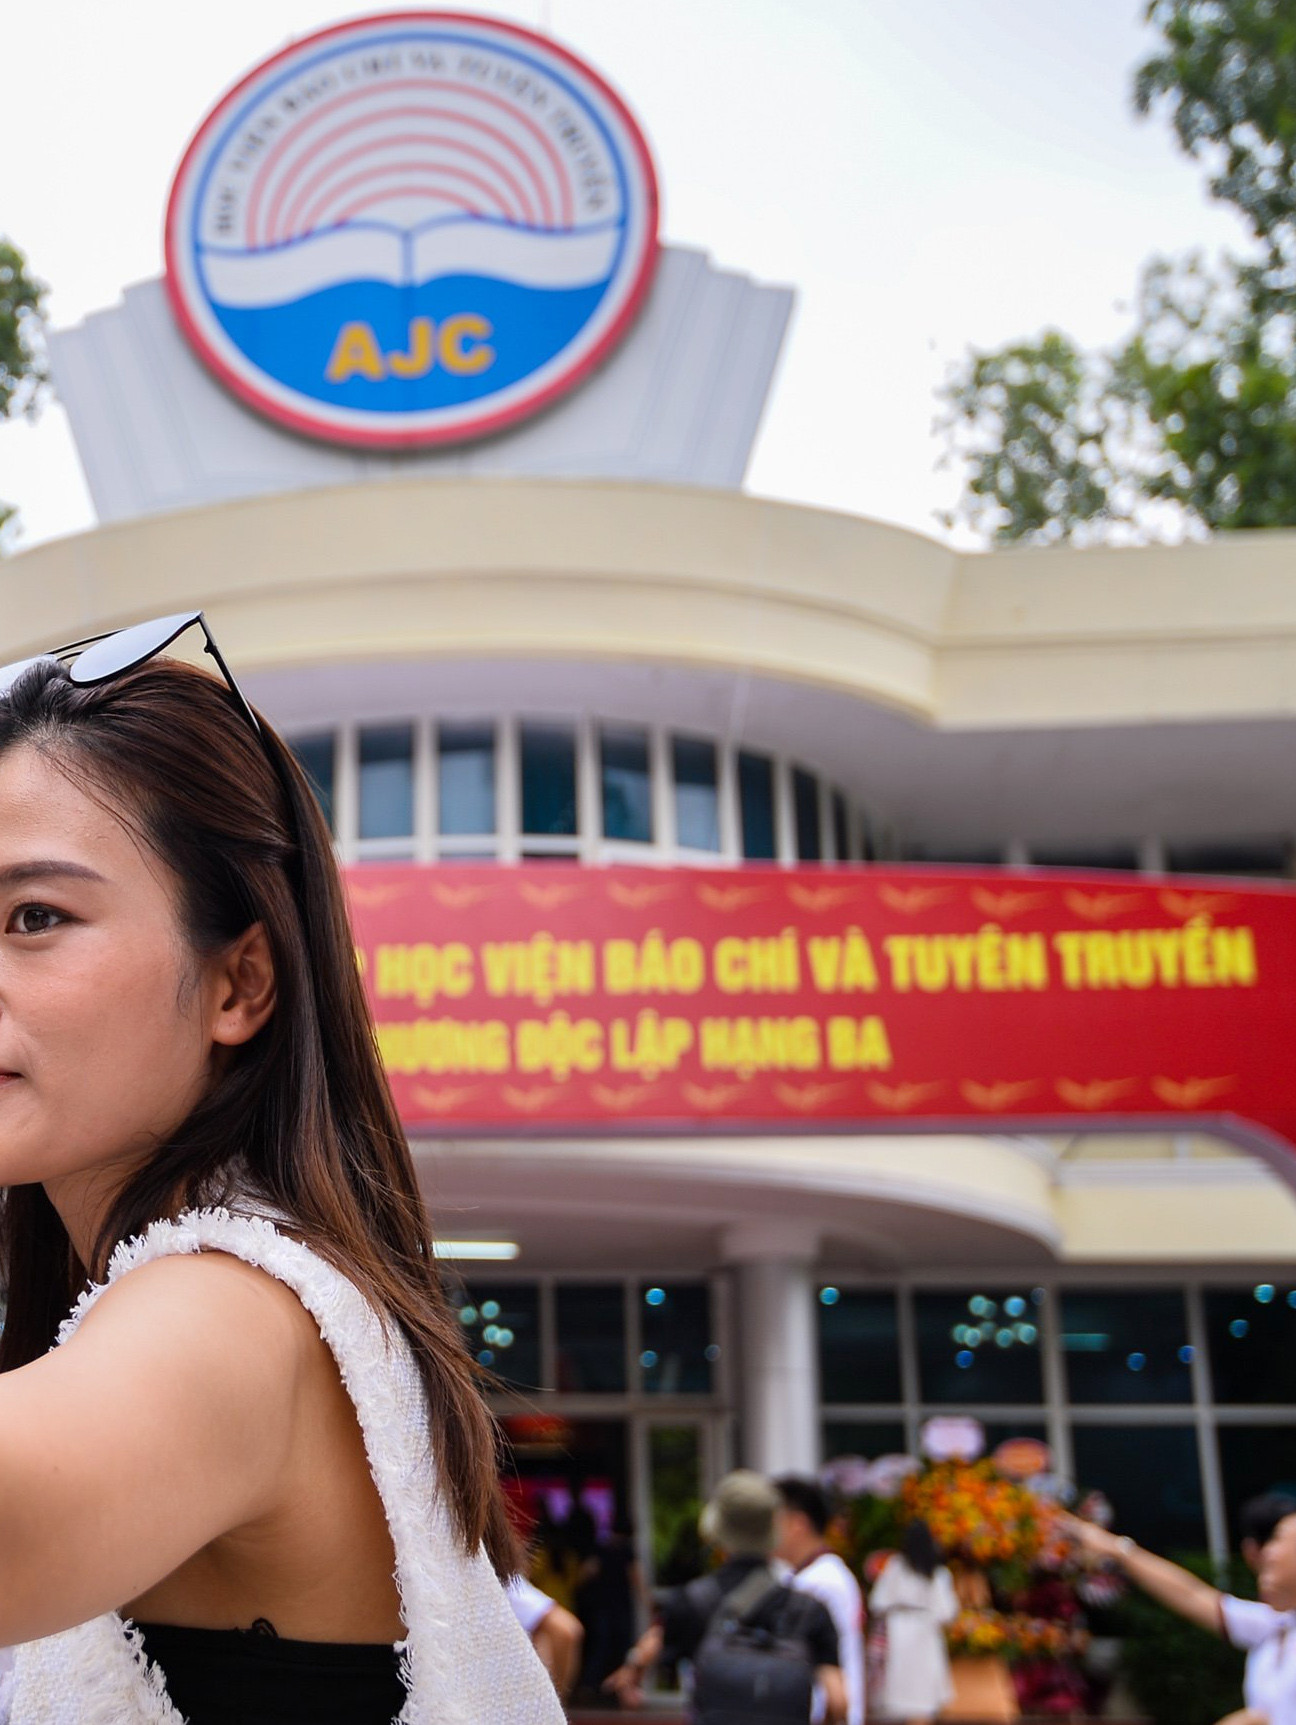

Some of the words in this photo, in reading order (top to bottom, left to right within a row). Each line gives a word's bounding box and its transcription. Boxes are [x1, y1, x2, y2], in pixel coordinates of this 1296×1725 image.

[325, 313, 495, 384] AJC
[375, 941, 474, 1008] HỌC
[481, 931, 596, 1005] VIỆN
[604, 928, 705, 995] BÁO
[713, 925, 800, 994] CHÍ
[808, 925, 878, 993] VÀ
[883, 922, 1049, 992] TUYÊN
[1054, 911, 1257, 990] TRUYỀN
[375, 1018, 511, 1075] HƯƠNG
[609, 1007, 693, 1081] LẬP
[699, 1016, 822, 1080] HẠNG
[827, 1016, 892, 1071] BA
